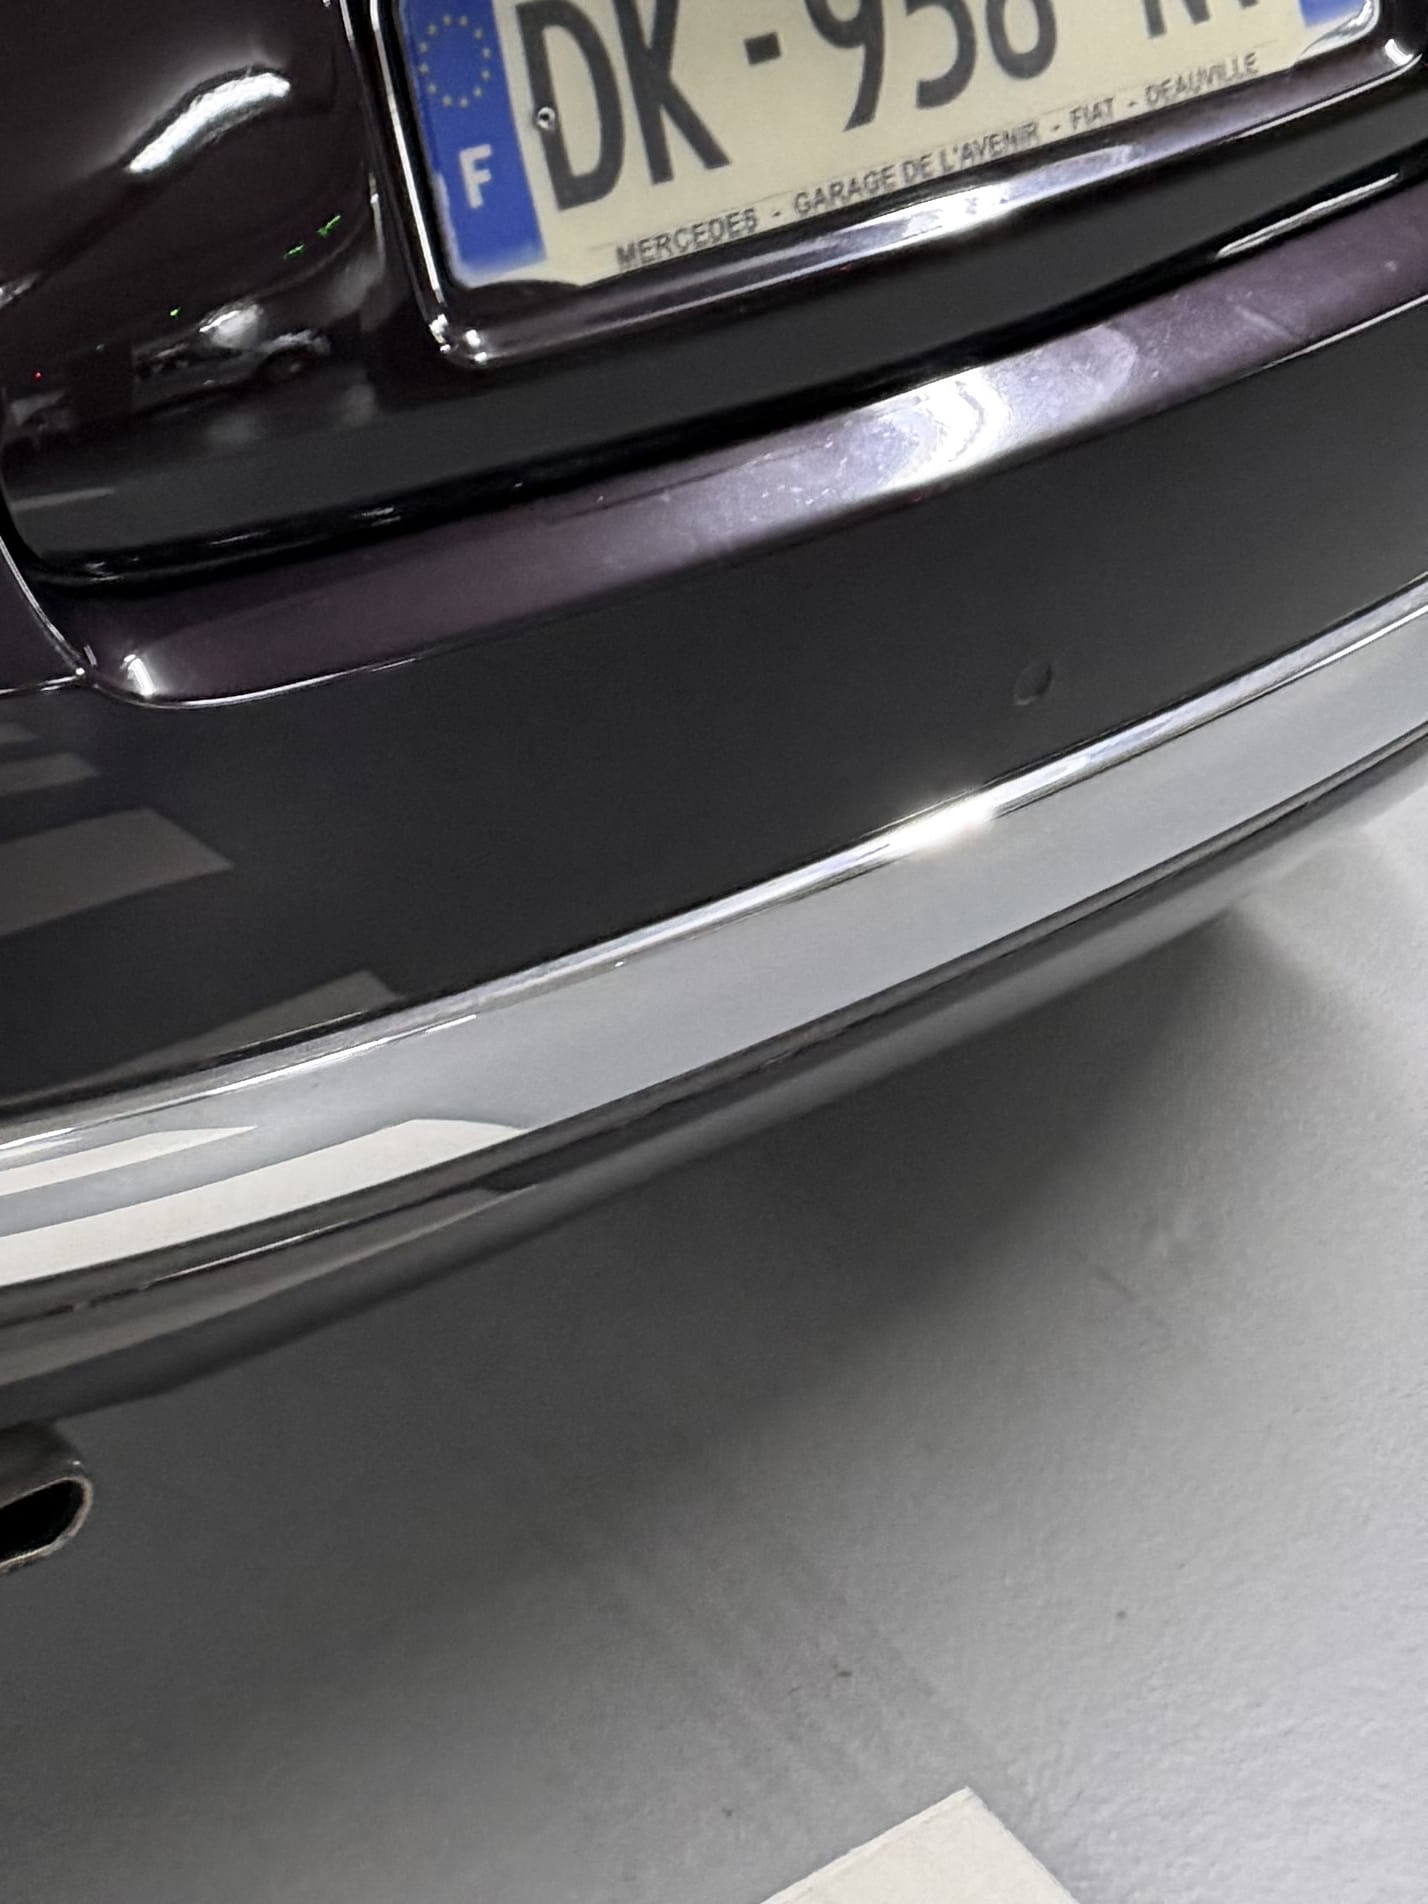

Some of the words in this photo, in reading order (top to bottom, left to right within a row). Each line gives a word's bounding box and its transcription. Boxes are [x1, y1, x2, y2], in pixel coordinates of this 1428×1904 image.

[459, 143, 492, 210] F
[616, 207, 758, 270] MERCEDES
[794, 164, 896, 217] GARAGE
[900, 152, 935, 187] DE
[939, 120, 1039, 174] L'AVENIR
[1069, 96, 1115, 130] FIAT
[1144, 51, 1260, 106] DEAUVILLE
